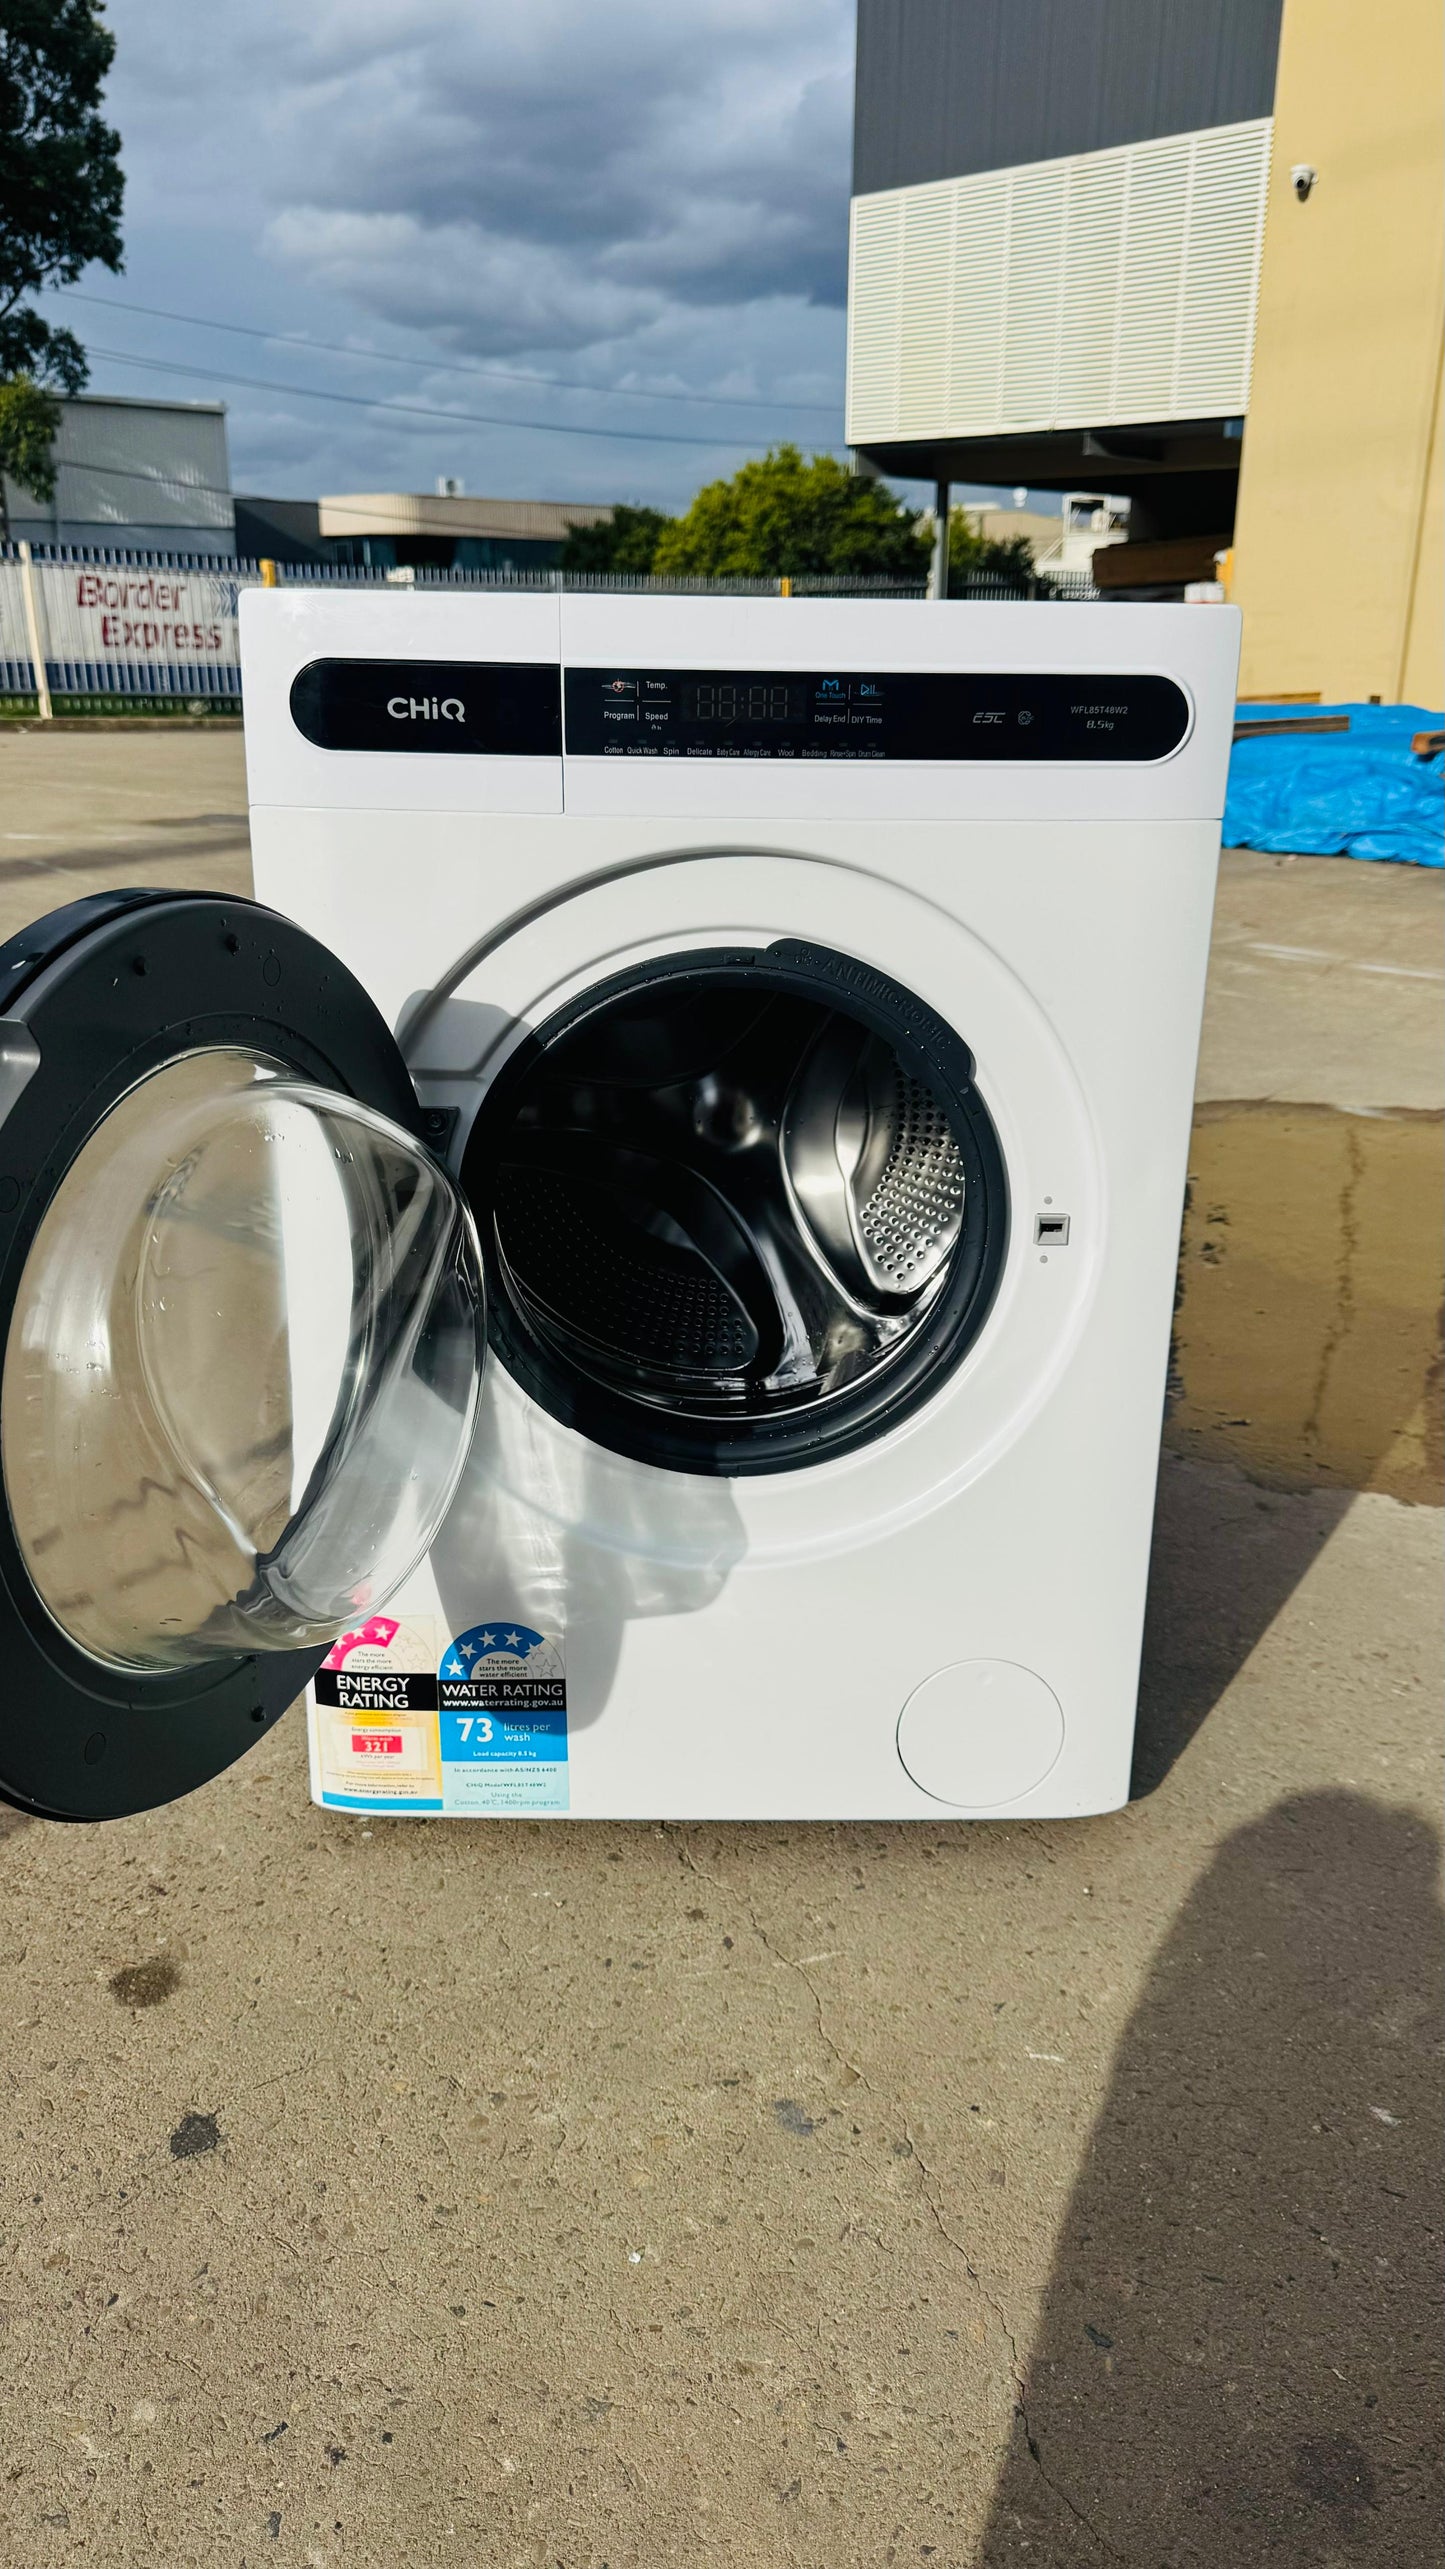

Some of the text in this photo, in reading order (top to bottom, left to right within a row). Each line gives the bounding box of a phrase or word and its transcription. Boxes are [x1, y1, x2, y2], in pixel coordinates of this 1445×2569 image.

[77, 575, 187, 611] Border
[102, 615, 222, 651] Express
[646, 681, 668, 690] Temp.
[1070, 706, 1128, 715] WFL85T48W2
[603, 711, 635, 721] Program
[645, 712, 669, 721] Speed
[814, 715, 846, 724] Delay End
[866, 717, 883, 725] Time
[604, 746, 623, 754] Cotton
[626, 746, 658, 755] Quick Wash
[663, 747, 680, 756] Spin
[686, 747, 713, 756] Delicate
[717, 749, 728, 757] Baby
[778, 749, 795, 757] Wool
[802, 750, 827, 758] Bedding
[336, 1674, 410, 1692] ENERGY
[442, 1684, 563, 1697] WATER RATING
[339, 1691, 409, 1708] RATING
[443, 1698, 564, 1708] www.waterrating.gov.au
[456, 1717, 494, 1742] 73
[504, 1722, 551, 1733] litres per
[504, 1732, 531, 1742] wash
[364, 1741, 389, 1752] 321
[528, 1750, 537, 1758] kg
